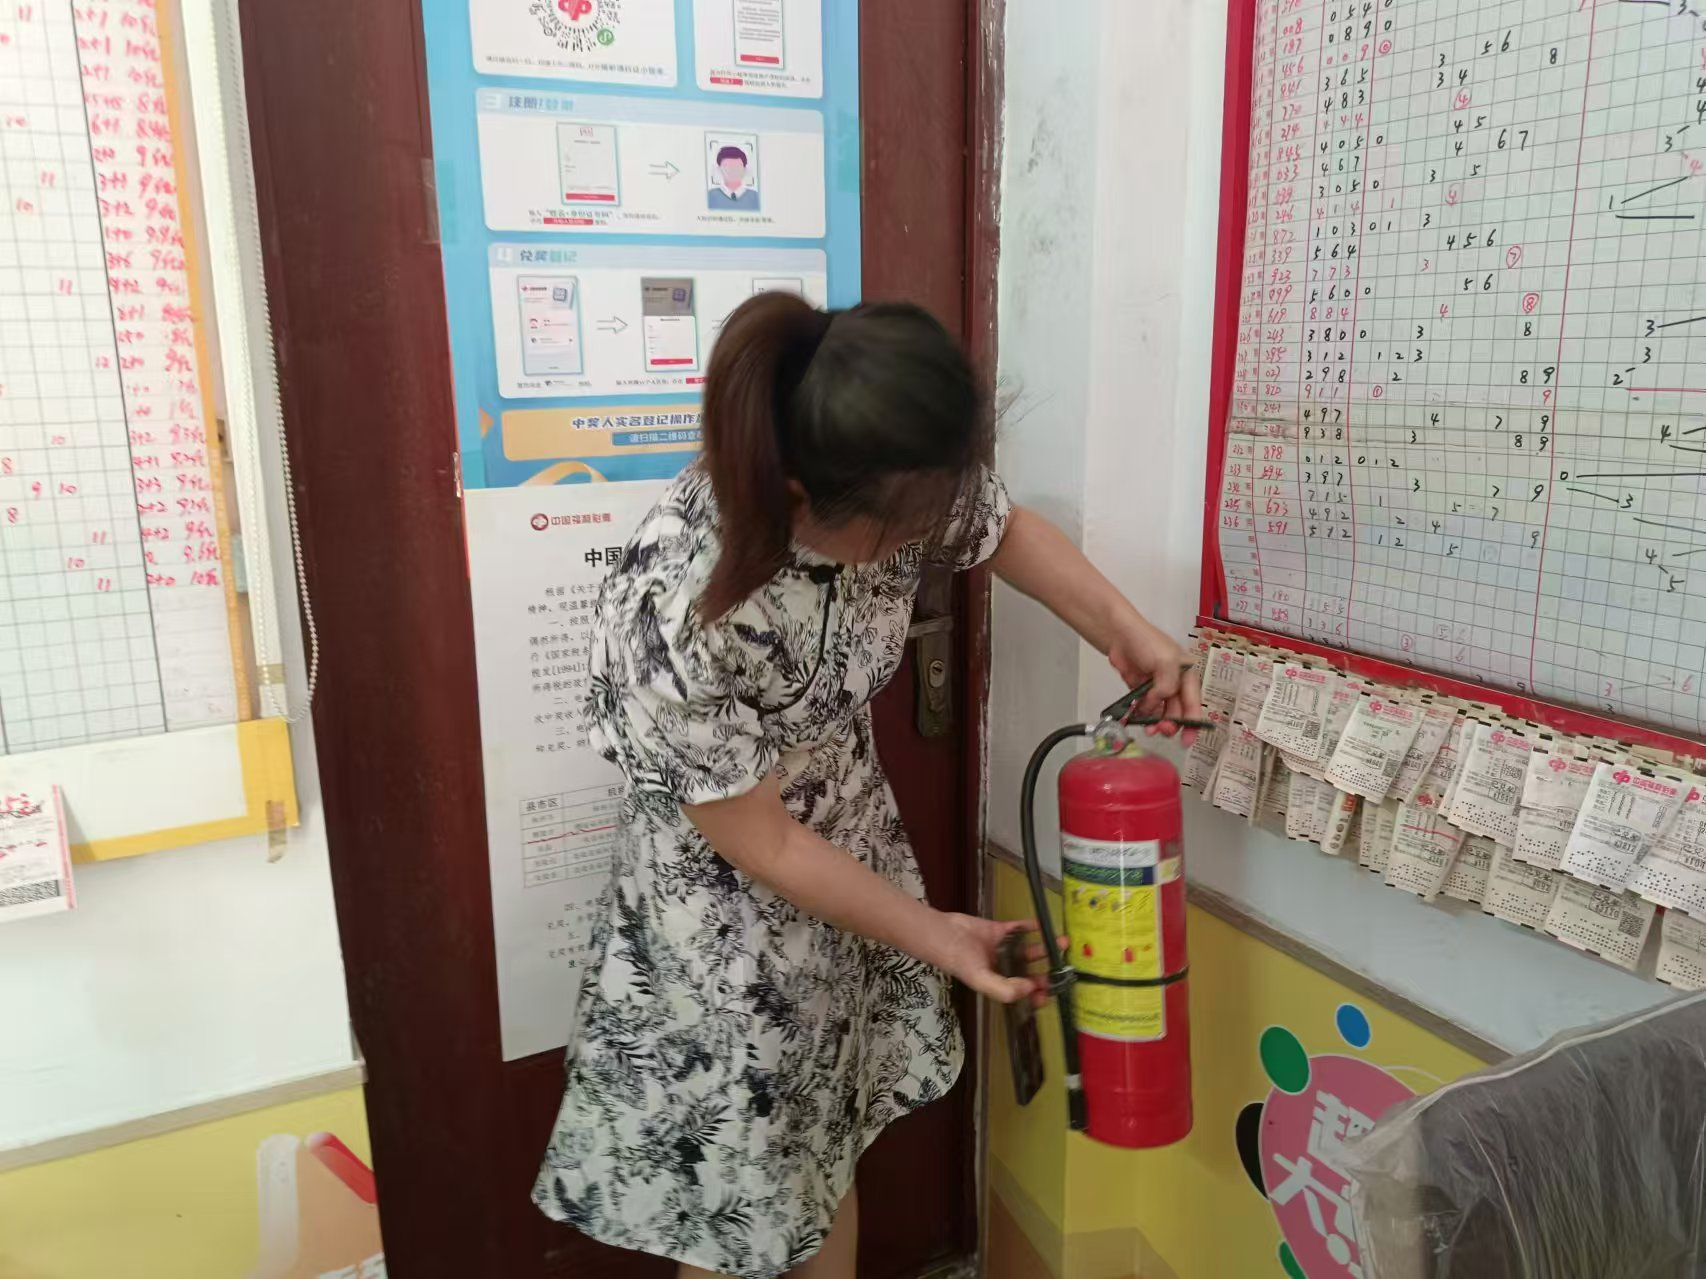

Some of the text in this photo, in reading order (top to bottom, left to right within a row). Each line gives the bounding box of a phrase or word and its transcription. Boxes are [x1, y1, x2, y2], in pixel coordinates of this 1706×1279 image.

[1346, 3, 1371, 20] 5 4
[1345, 26, 1352, 41] 8
[1364, 21, 1371, 38] 9
[1385, 21, 1392, 30] 0
[1325, 31, 1511, 91] 3 6 5 3 5 6
[1324, 48, 1557, 114] 4 8 3 3 4 8
[1321, 116, 1486, 153] 4 5 4 5
[1665, 136, 1672, 152] 3
[1322, 129, 1528, 177] 4 6 7 4 6 7
[1319, 165, 1480, 199] 3 5 0 3 5
[1351, 222, 1355, 236] 3
[1423, 214, 1430, 227] 3
[1314, 246, 1321, 260] 5
[1331, 244, 1339, 258] 6
[1348, 245, 1356, 260] 4
[1447, 235, 1455, 251] 4
[1463, 233, 1477, 248] 5
[1487, 229, 1496, 247] 6
[1309, 289, 1318, 304] 5
[1329, 285, 1335, 300] 6
[1464, 278, 1473, 290] 5
[1484, 274, 1493, 290] 6
[1310, 307, 1317, 320] 8
[1326, 307, 1333, 319] 8
[1340, 304, 1348, 319] 4
[1309, 330, 1315, 341] 3
[1324, 328, 1331, 342] 8
[1340, 331, 1346, 340] 0
[1417, 326, 1423, 339] 3
[1524, 322, 1531, 336] 8
[1645, 320, 1654, 337] 3
[1414, 349, 1422, 362] 3
[1642, 347, 1651, 363] 3
[1306, 371, 1313, 380] 2
[1322, 367, 1329, 381] 9
[1338, 370, 1346, 383] 8
[1392, 372, 1402, 381] 2
[1520, 370, 1528, 384] 8
[1543, 367, 1555, 384] 9
[1613, 374, 1623, 385] 2
[1305, 384, 1311, 399] 9
[1543, 390, 1551, 404] 9
[1304, 408, 1549, 432] 4 9 7 4 7 9
[1304, 427, 1548, 451] 9 8 3 8 9
[1661, 425, 1671, 443] 4
[1335, 456, 1568, 480] 2 0 2 0
[1305, 472, 1311, 483] 3
[1322, 471, 1328, 484] 9
[1337, 473, 1342, 486] 7
[1414, 479, 1420, 492] 3
[1493, 486, 1499, 497] 7
[1531, 485, 1544, 502] 9
[1308, 490, 1315, 502] 7
[1337, 492, 1347, 504] 5
[1452, 502, 1461, 512] 5
[1490, 507, 1499, 521] 7
[1621, 494, 1634, 508] 3
[551, 513, 611, 525] 中国福利彩票
[1264, 486, 1280, 495] 112
[1309, 509, 1320, 520] 4
[1325, 508, 1330, 521] 9
[1341, 512, 1349, 520] 2
[1432, 521, 1440, 534] 4
[1531, 531, 1539, 549] 9
[1309, 525, 1317, 537] 5
[1342, 529, 1352, 538] 2
[1395, 538, 1403, 546] 2
[1447, 544, 1458, 557] 5
[1646, 549, 1657, 565] 4
